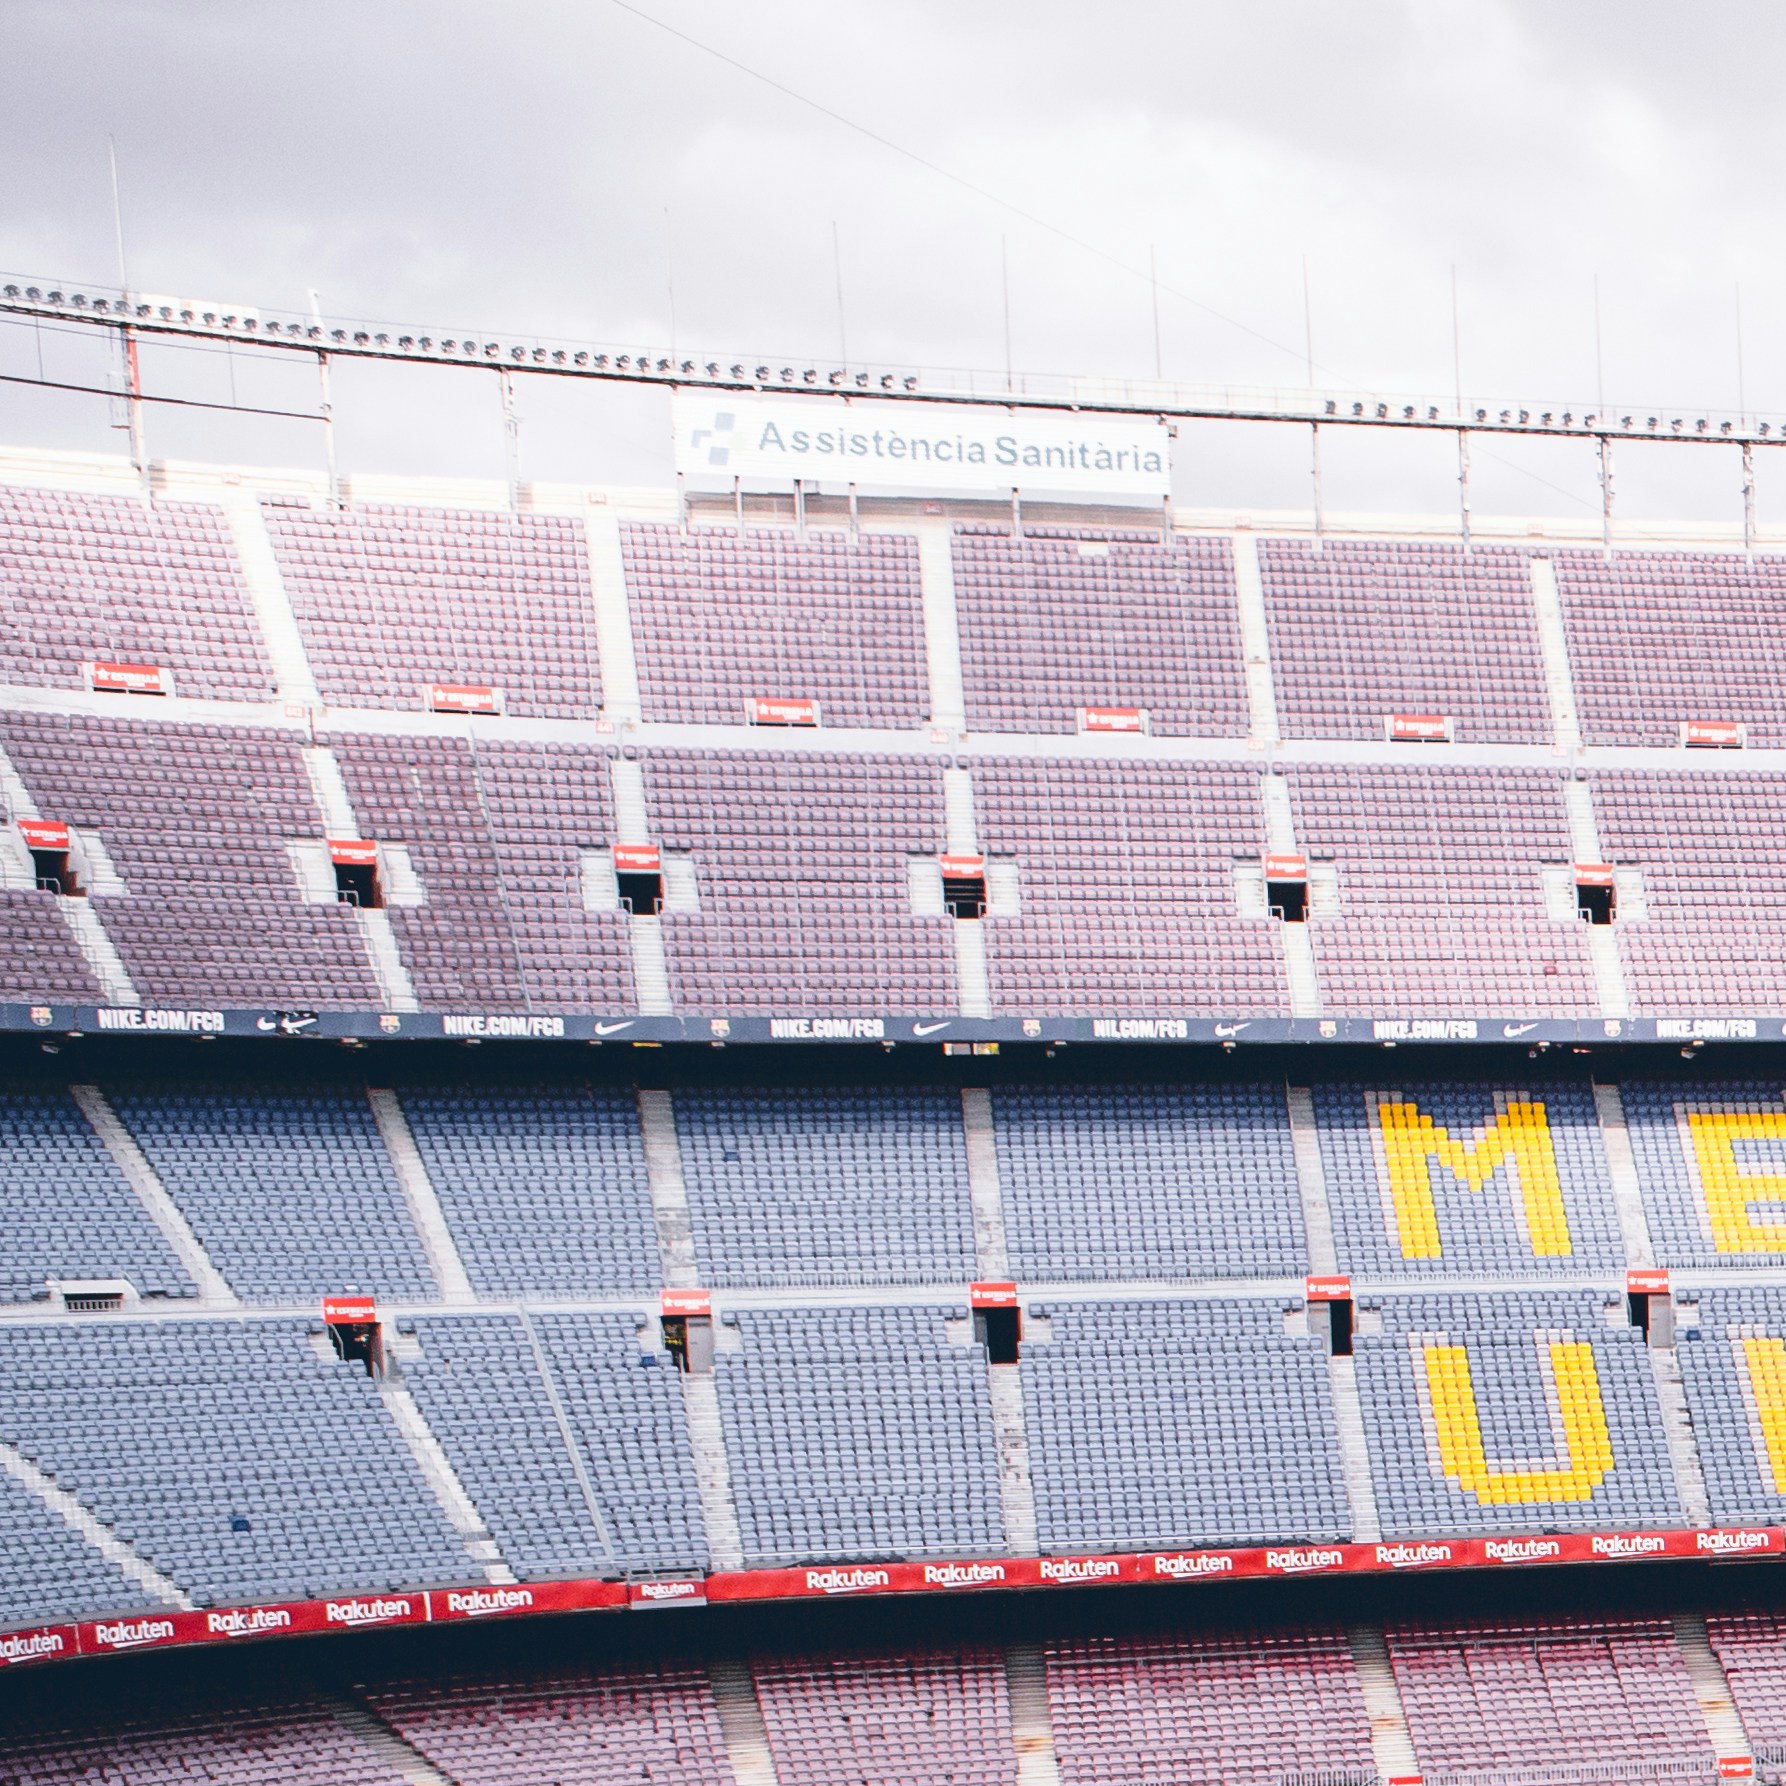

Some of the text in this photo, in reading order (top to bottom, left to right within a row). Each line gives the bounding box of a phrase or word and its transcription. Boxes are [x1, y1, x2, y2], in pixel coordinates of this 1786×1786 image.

[758, 420, 1163, 474] Assistència Sanitària
[97, 1008, 225, 1032] NIKE.COM/FCB
[443, 1015, 564, 1037] NIKE.COM/FCB
[770, 1018, 885, 1038] NIKE.COM/FCB
[1373, 1020, 1477, 1040] NIKE.COM/FCB
[1656, 1019, 1757, 1039] NIKE.COM/FCB
[1485, 1538, 1559, 1557] Rakuten
[1591, 1535, 1665, 1553] Rakuten
[1696, 1531, 1769, 1549] Rakuten
[1266, 1549, 1342, 1568] Rakuten
[1376, 1544, 1451, 1562] Rakuten
[924, 1563, 1005, 1584] Rakuten
[1040, 1559, 1119, 1578] Rakuten
[1154, 1554, 1233, 1573] Rakuten
[806, 1567, 889, 1588] Rakuten
[641, 1580, 695, 1597] Rakuten
[326, 1598, 411, 1622] Rakuten
[447, 1590, 533, 1611] Rakuten
[208, 1608, 290, 1632] Rakuten
[96, 1620, 174, 1646] Rakuten
